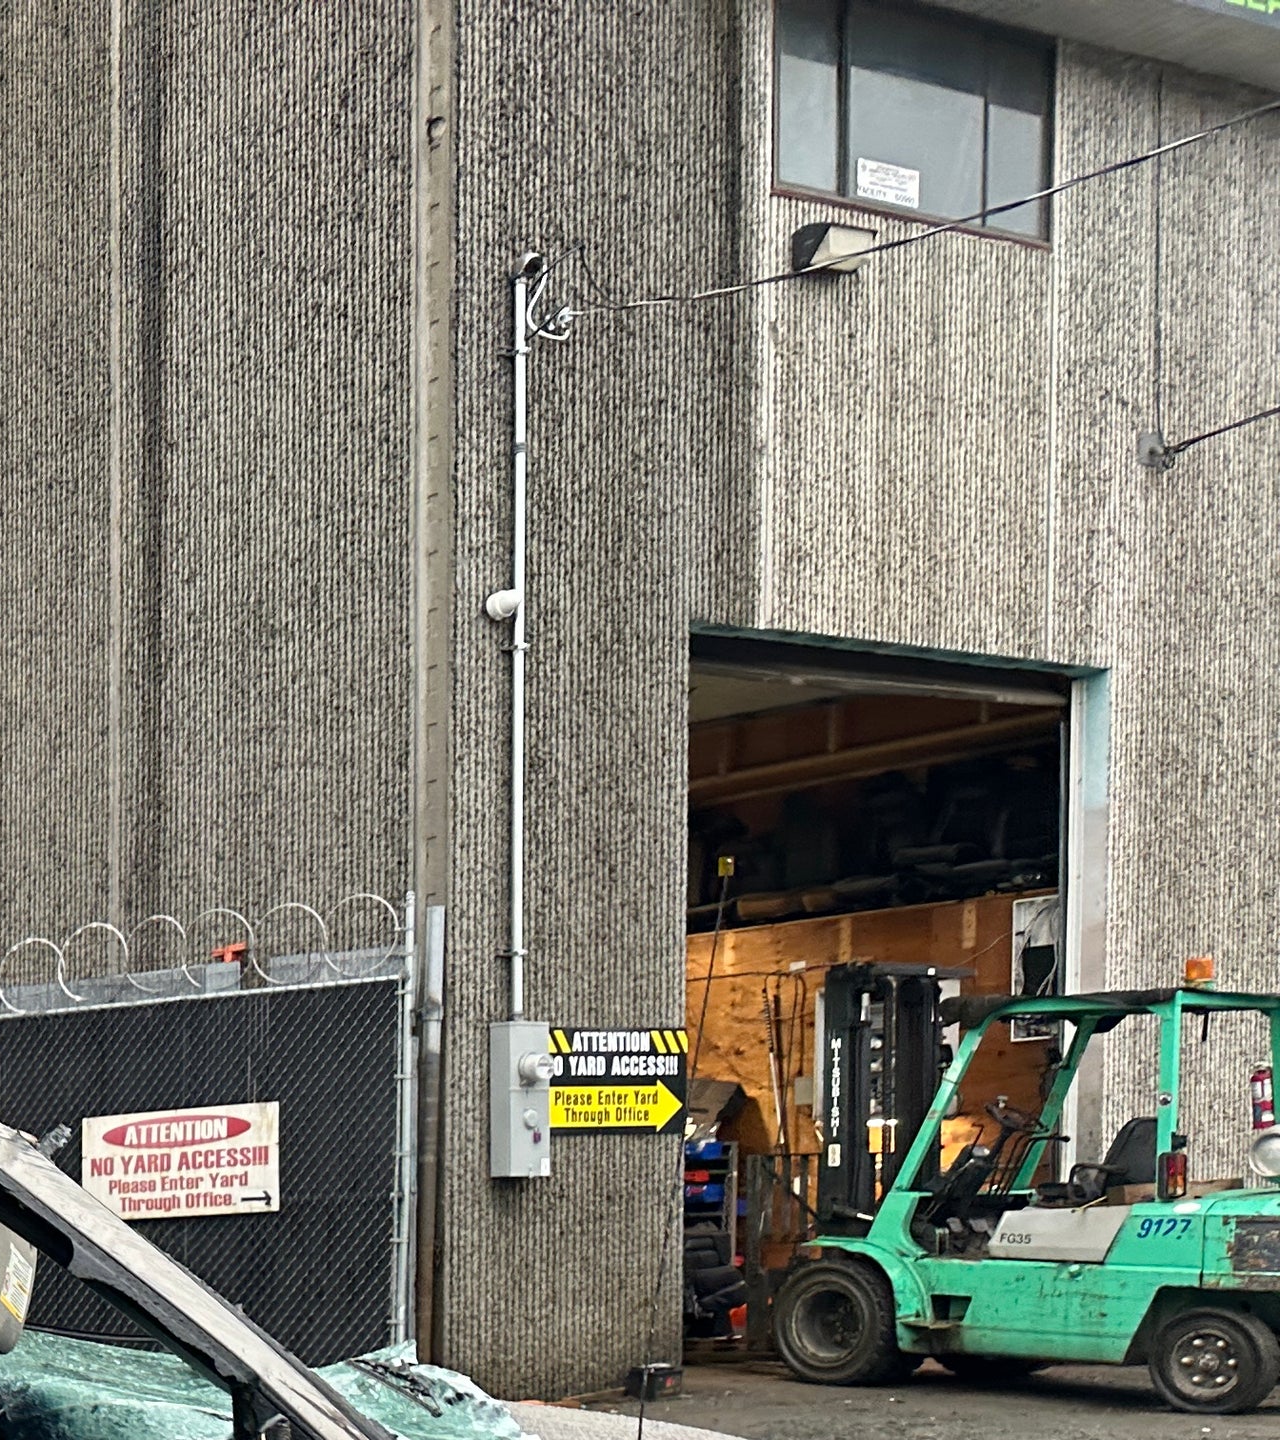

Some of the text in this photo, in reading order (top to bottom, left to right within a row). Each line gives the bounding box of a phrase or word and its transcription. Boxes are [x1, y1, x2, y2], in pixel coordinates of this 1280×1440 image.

[572, 1031, 651, 1053] ATTENTION
[569, 1056, 606, 1077] YARD
[611, 1055, 679, 1077] ACCESS!!!
[554, 1089, 659, 1106] Please Enter Yard
[830, 1037, 842, 1138] MITSUBISHI
[564, 1107, 650, 1125] Through Office
[124, 1117, 229, 1146] ATTENTION
[90, 1146, 270, 1177] NO YARD ACCESS!!!
[108, 1171, 249, 1196] Please Enter Yard
[120, 1195, 181, 1213] Through
[999, 1232, 1032, 1245] FG35
